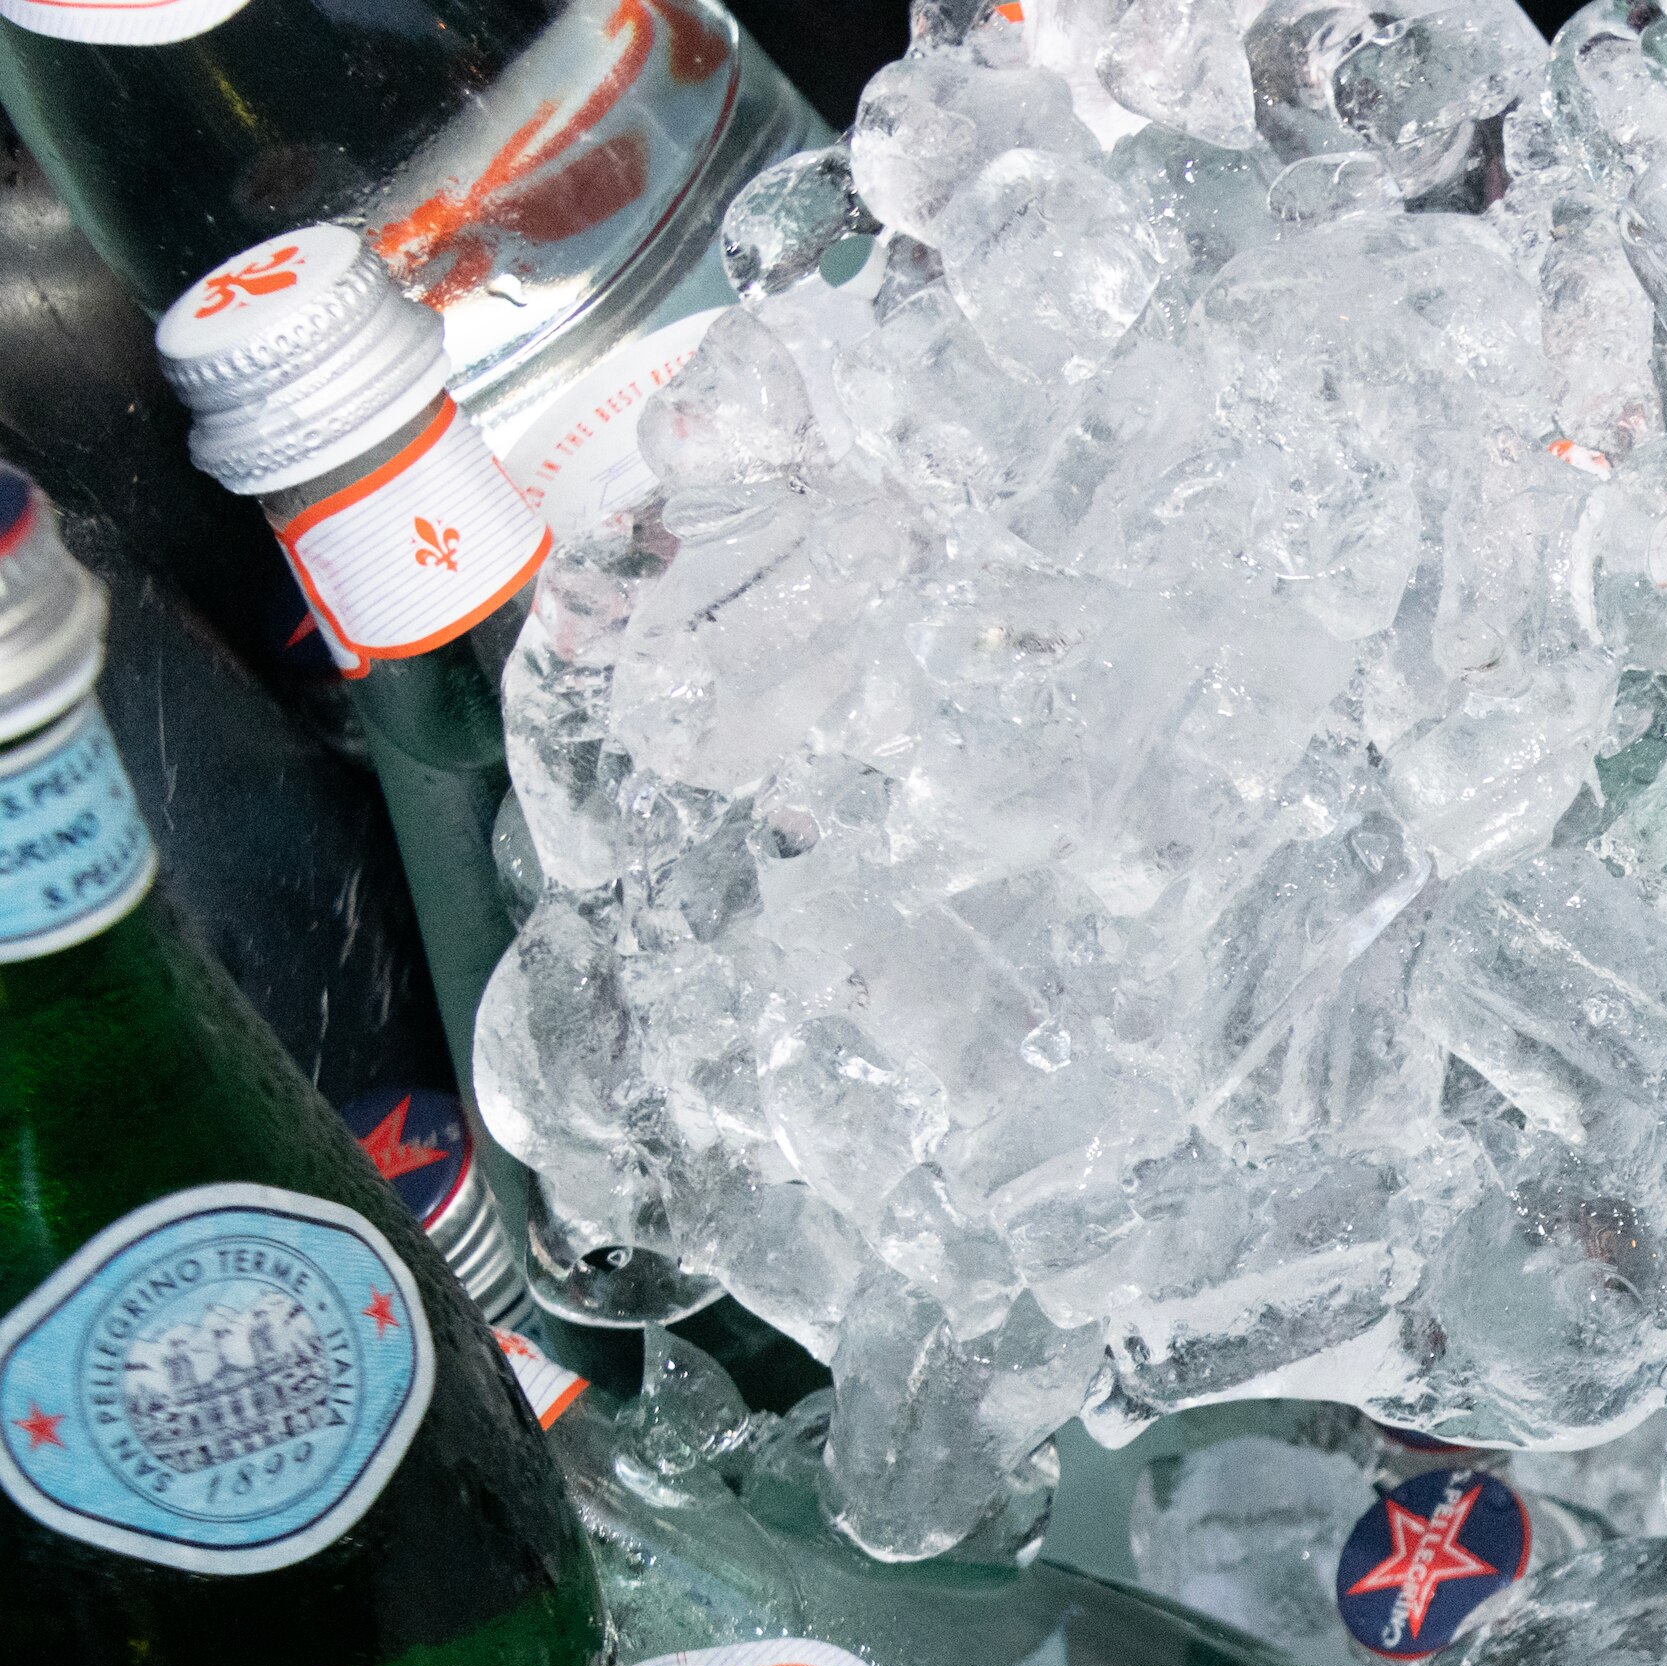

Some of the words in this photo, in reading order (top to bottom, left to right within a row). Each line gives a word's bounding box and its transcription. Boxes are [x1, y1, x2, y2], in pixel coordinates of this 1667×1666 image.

[217, 1249, 310, 1296] TERME
[93, 1257, 202, 1425] PELLEGRINO
[325, 1326, 354, 1426] ITALIA
[110, 1437, 173, 1493] SAN
